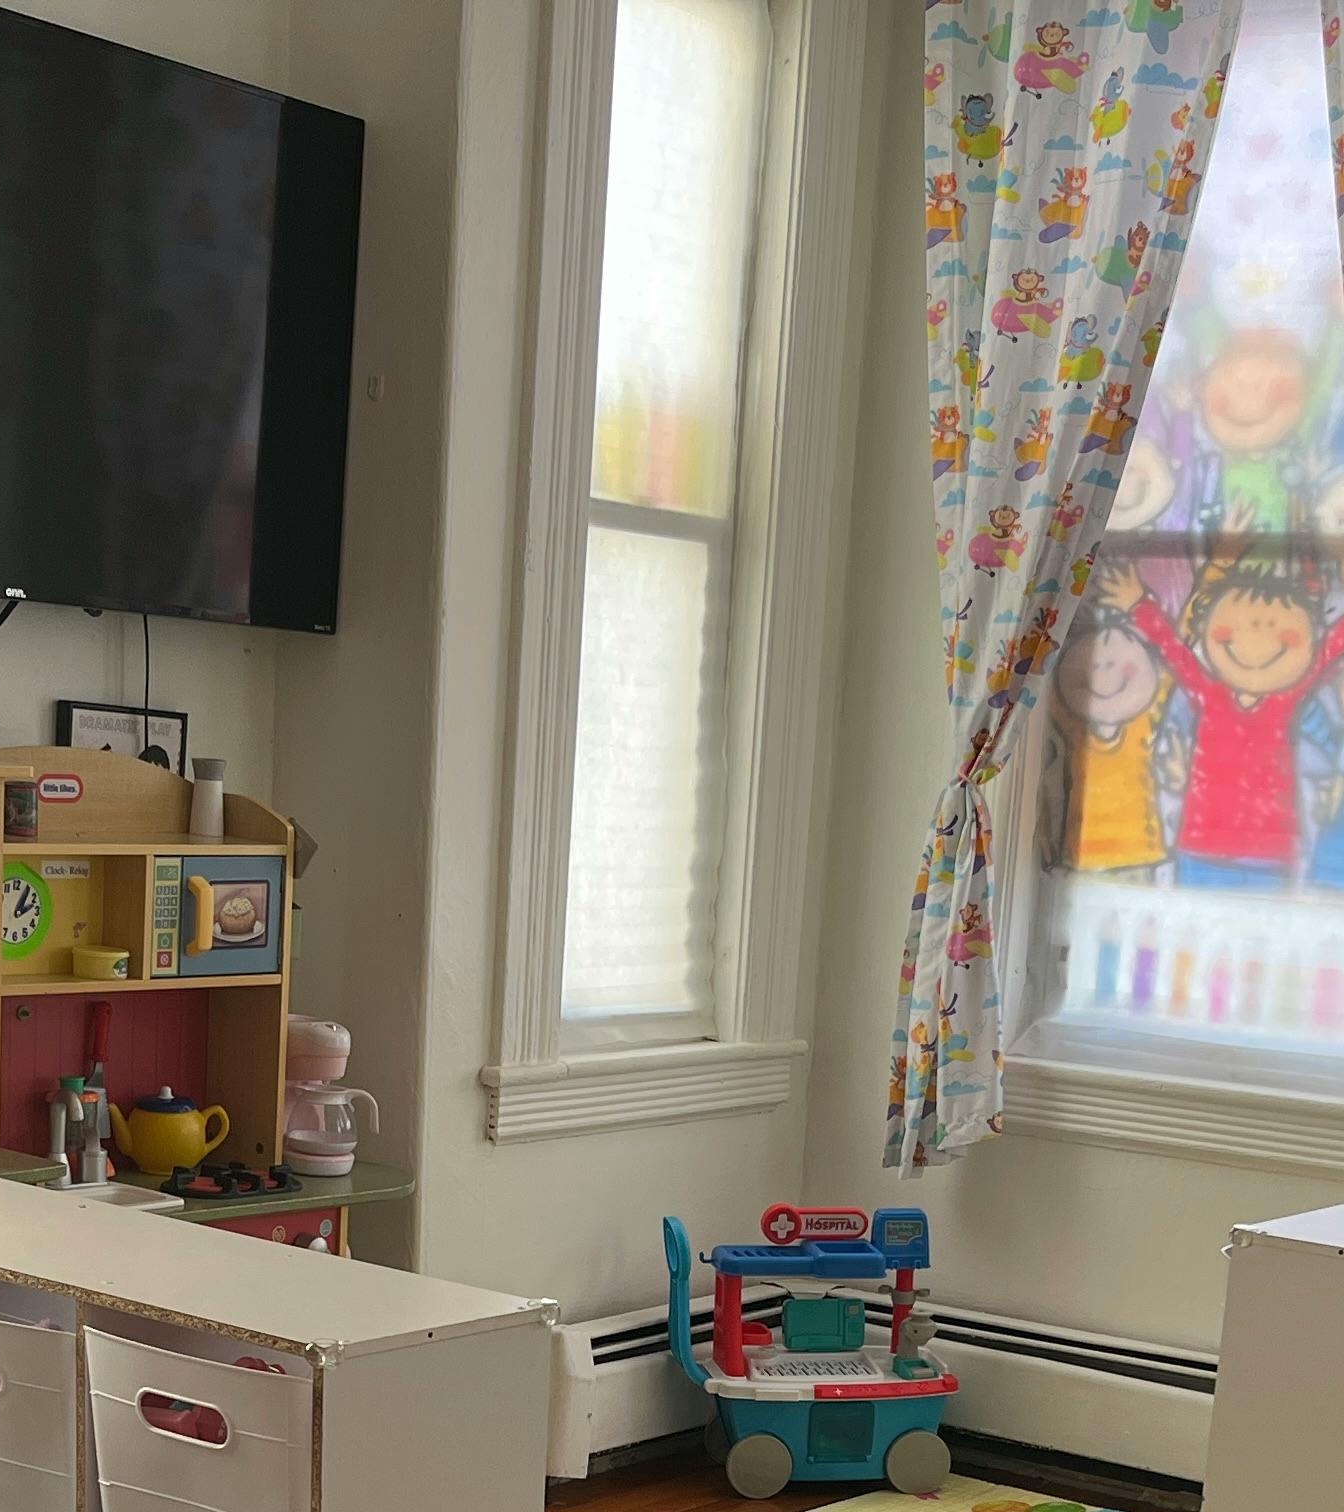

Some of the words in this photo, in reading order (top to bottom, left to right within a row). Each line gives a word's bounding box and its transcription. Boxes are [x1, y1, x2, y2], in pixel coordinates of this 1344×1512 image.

[12, 879, 22, 891] 12
[31, 892, 38, 904] 2
[34, 905, 41, 917] 3
[29, 918, 36, 929] 4
[2, 927, 9, 939] 7
[11, 931, 19, 942] 6
[22, 927, 29, 939] 5
[804, 1217, 860, 1232] HOSPITAL
